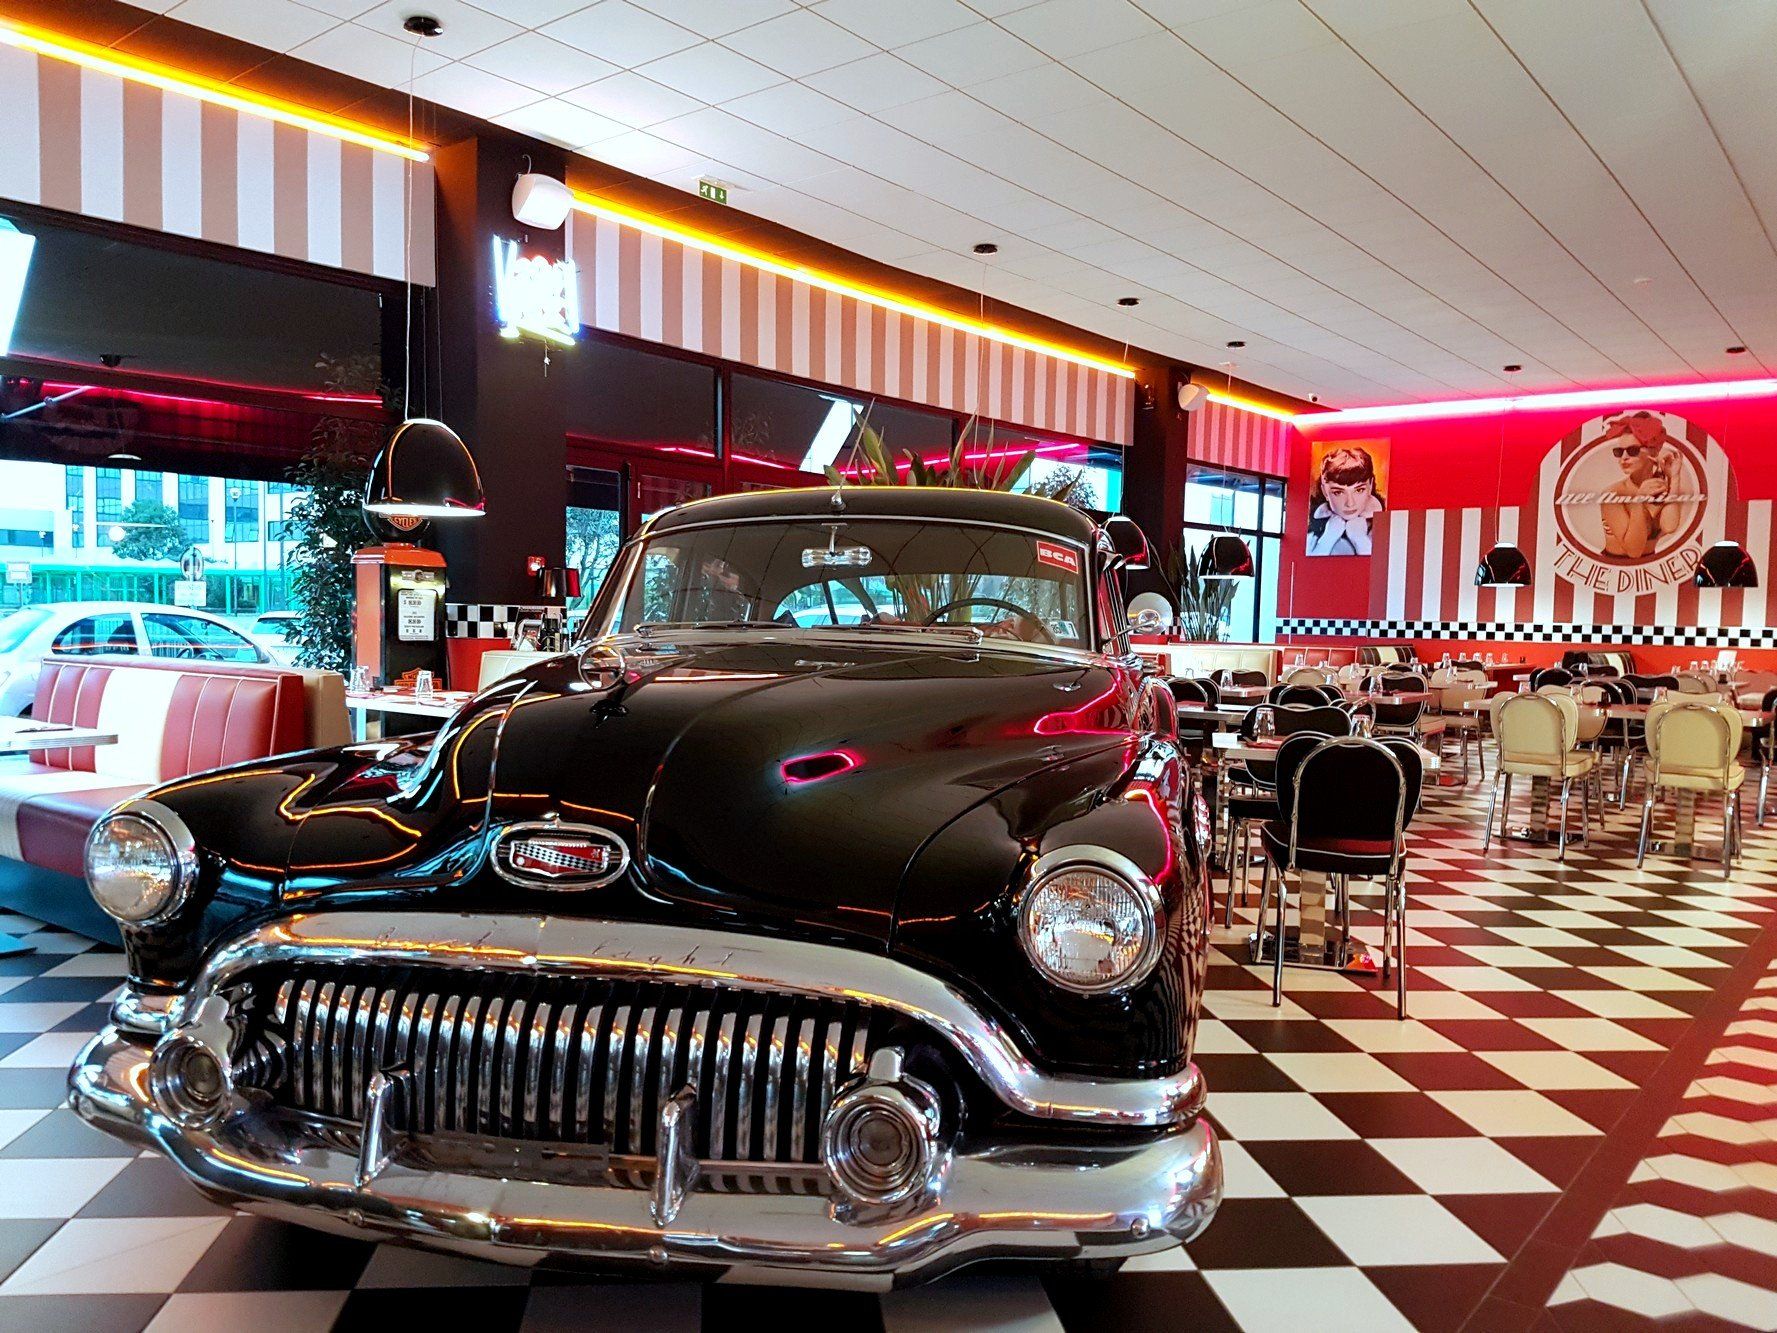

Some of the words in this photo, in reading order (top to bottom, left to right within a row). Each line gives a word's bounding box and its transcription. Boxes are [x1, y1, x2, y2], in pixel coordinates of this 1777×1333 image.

[1597, 491, 1708, 505] American
[1039, 548, 1077, 566] BCA
[1554, 543, 1610, 593] THE
[1616, 549, 1702, 592] DINER
